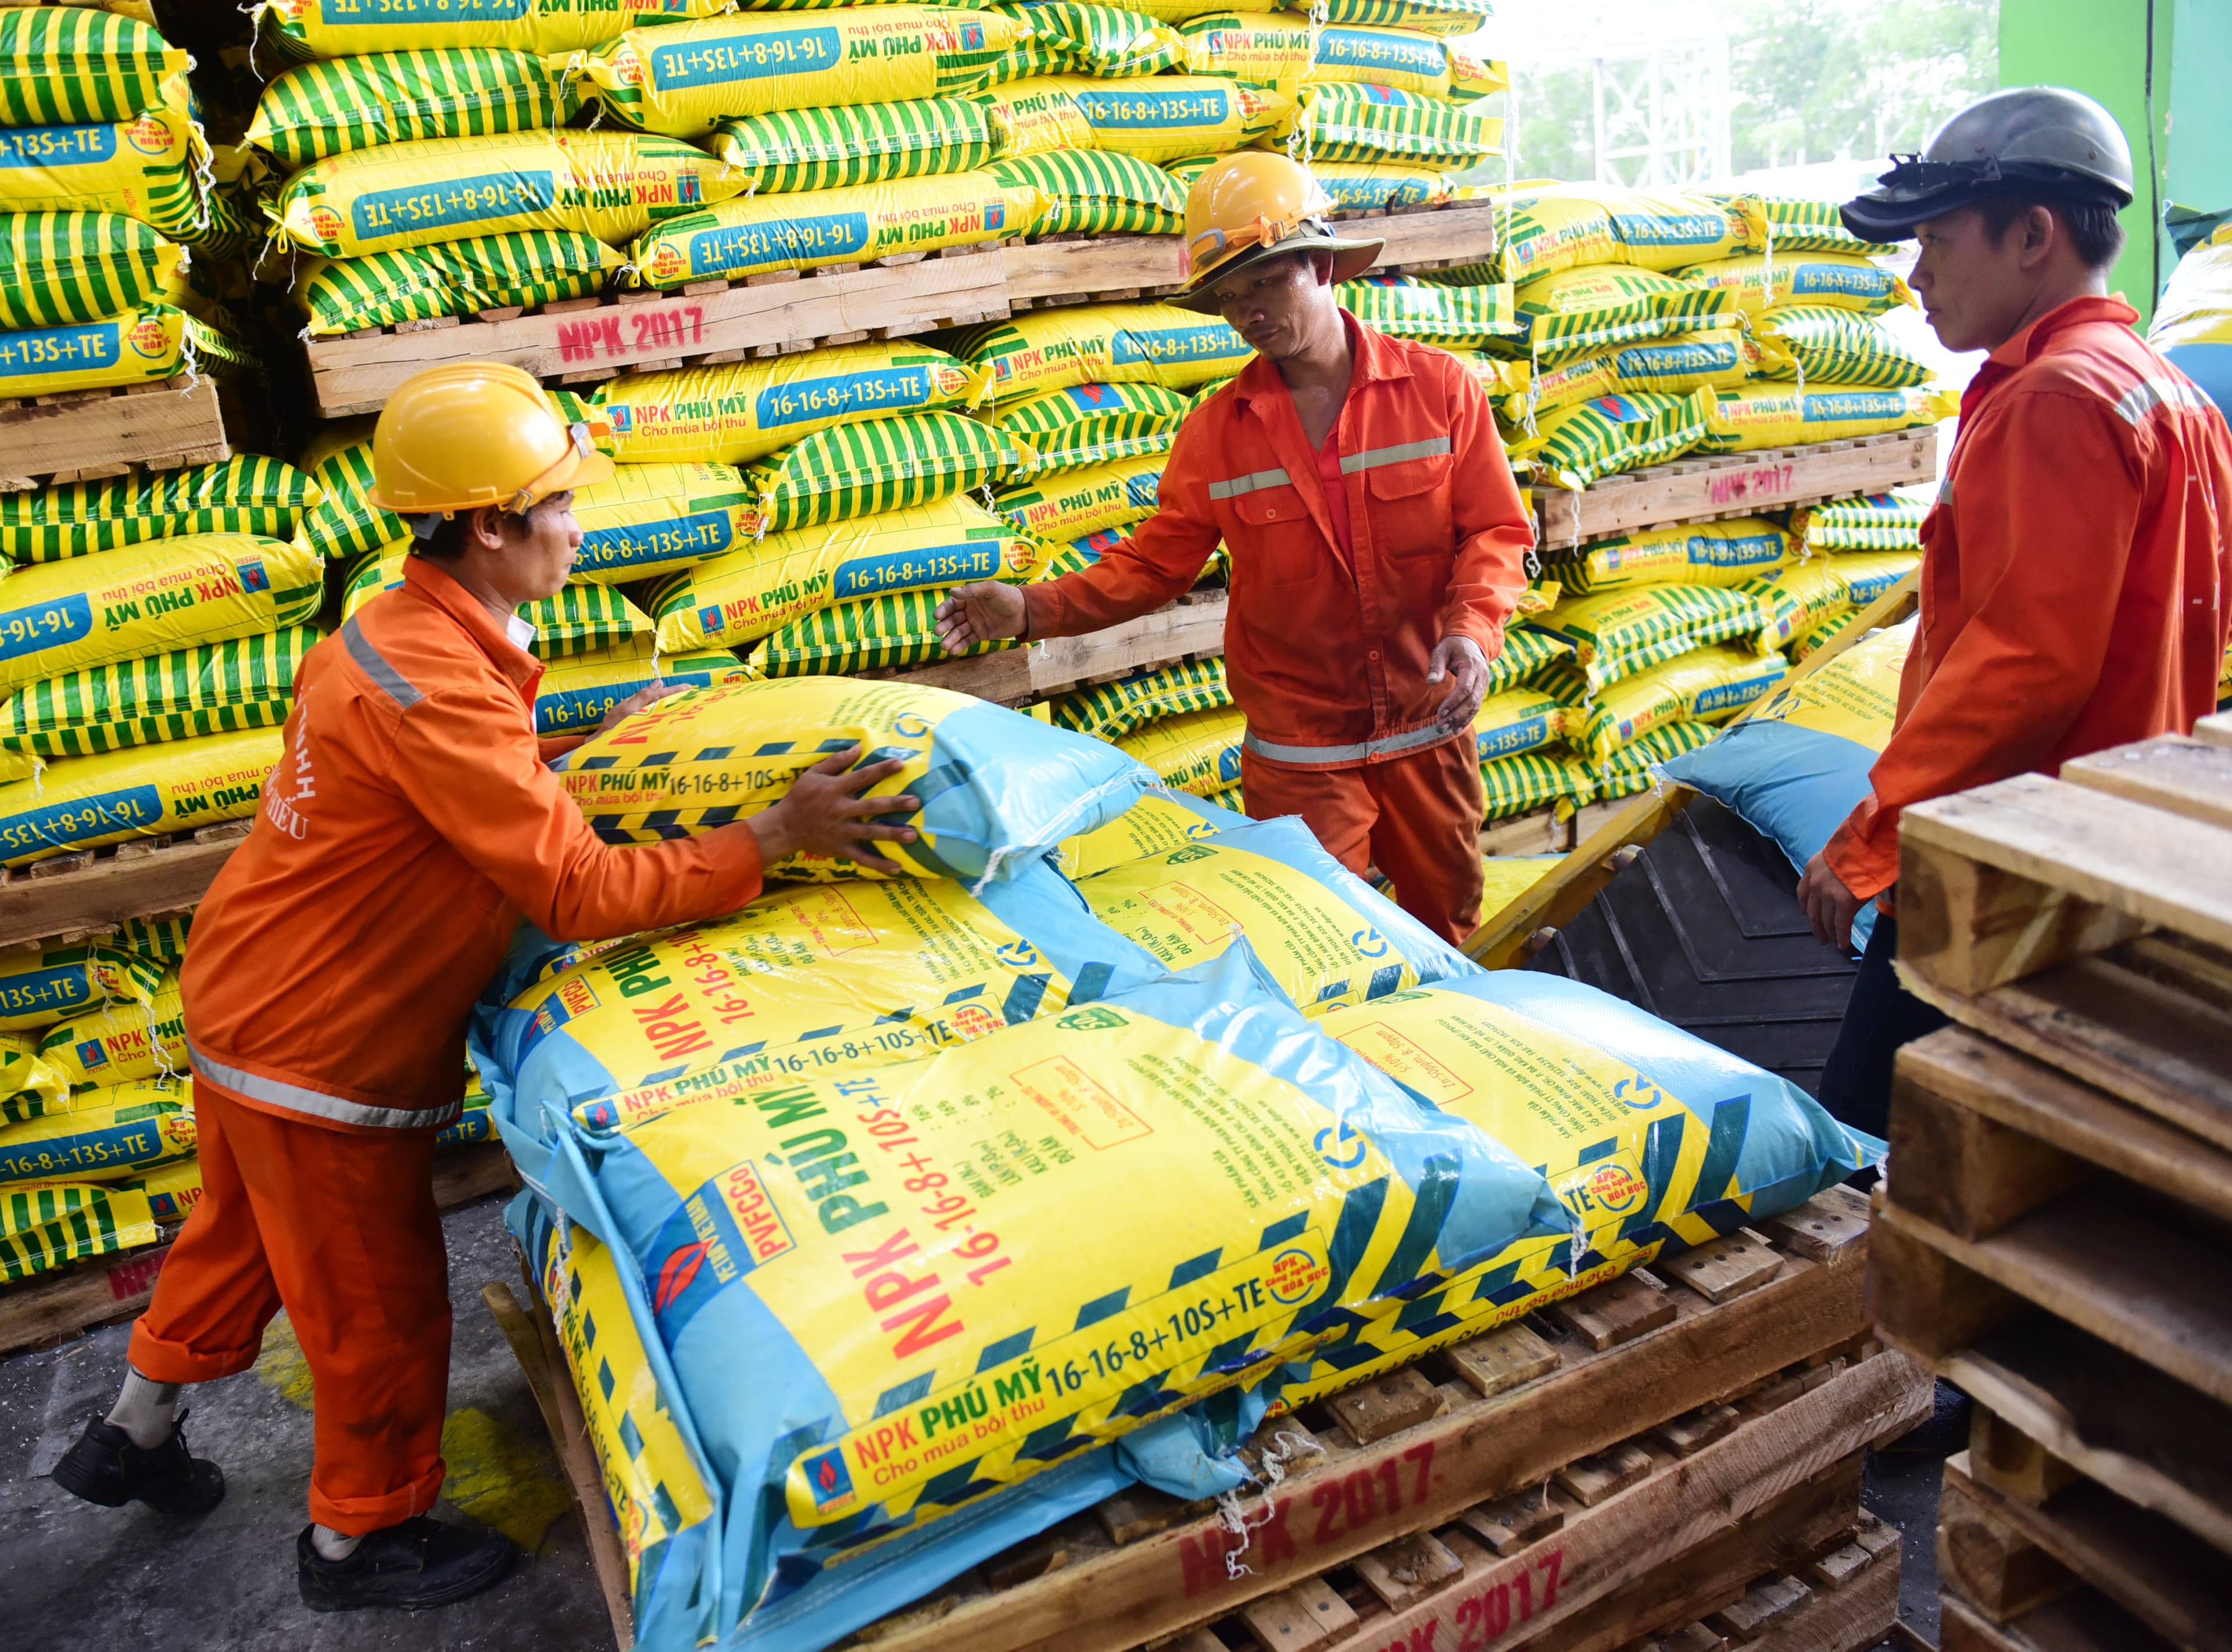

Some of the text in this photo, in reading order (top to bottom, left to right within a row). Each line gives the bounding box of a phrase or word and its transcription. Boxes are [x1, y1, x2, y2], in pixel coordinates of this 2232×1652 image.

[848, 19, 951, 35] Cho mùa bội thu
[1224, 30, 1285, 50] NPK PHÚ
[664, 31, 957, 78] NPK PHÚ MỸ 16-16-8+13S+TE
[1227, 51, 1307, 63] Cho mùa thu
[1014, 91, 1219, 121] PHÚ 16-16-8+13S+TE
[606, 171, 667, 184] Cho mùa
[367, 182, 673, 227] NPK PHÚ MỸ 16-16-8+13S+TE
[877, 202, 976, 221] Cho mùa bội thu
[702, 213, 981, 264] NPK PHÚ MỸ 16-16-8+13S+TE
[1534, 234, 1558, 253] NPK
[1803, 272, 1891, 291] 16-16-8+13S+TE
[557, 307, 704, 364] NPK 2017
[1012, 334, 1106, 371] NPK PHÚ MỸ
[1019, 356, 1106, 381] Cho mùa thu
[1541, 371, 1566, 391] NPK
[635, 375, 921, 424] NPK PHÚ MỸ 16-16-8+13S+TE
[1729, 397, 1901, 416] NPK PHÚ 16-16-8+13S+TE
[641, 417, 746, 437] Cho mùa bội thu
[1752, 465, 1793, 496] 2017
[1028, 482, 1121, 524] NPK PHÚ MỸ
[1035, 501, 1122, 533] Cho mùa bội thu
[102, 564, 227, 600] Cho mùa bội thu
[725, 552, 990, 621] NPK PHÚ MỸ 16-16-8+13S+TE
[104, 576, 239, 632] NPK PHÚ MỸ
[732, 609, 788, 630] Cho mùa
[1632, 706, 1654, 730] NPK
[171, 769, 261, 794] mùa bội thu
[566, 773, 598, 794] NPK
[600, 764, 639, 791] PHÚ
[641, 766, 670, 789] MỸ
[1161, 755, 1212, 788] PHÚ MỸ
[174, 794, 209, 820] MỸ
[213, 783, 259, 811] PHÚ
[1274, 914, 1287, 927] BÓN
[1283, 923, 1299, 939] PHÂN
[1315, 923, 1328, 936] 028.
[1296, 936, 1305, 945] TY
[1314, 906, 1363, 962] WEBSITE: www.dpm.vn
[1283, 939, 1317, 978] SẢN PHẨM CỦA
[1300, 943, 1318, 960] CÔNG
[1315, 940, 1329, 955] MẠC
[1336, 949, 1353, 966] ĐIỆN
[632, 992, 714, 1061] NPK
[956, 1008, 977, 1020] NPK
[106, 1030, 146, 1054] NPK
[117, 1049, 146, 1063] Cho
[623, 1018, 954, 1113] NPK PHÚ MỸ 16-16-8+10S+TE
[1376, 1030, 1455, 1089] Zn:50ppm, 50ppm
[715, 1072, 774, 1099] bội thu
[1562, 1058, 1631, 1116] WEBSITE: www.dpm.vn
[1537, 1108, 1559, 1128] PHẨM
[1590, 1181, 1611, 1195] Công
[1594, 1169, 1616, 1185] NPK
[1607, 1181, 1646, 1204] HÓA HỌC
[729, 1168, 787, 1258] PVFCCo
[732, 1085, 965, 1360] NPK PHÚ MỸ
[1273, 1256, 1297, 1275] NPK
[1265, 1270, 1288, 1289] Công
[1281, 1266, 1329, 1294] HÓA HỌC
[853, 1277, 1265, 1470] NPK PHÚ MỸ 16-16-8+10S+TE
[873, 1397, 1045, 1486] Cho mùa bội thu
[1312, 1439, 1437, 1546] 2017
[1455, 1549, 1564, 1652] 2017
